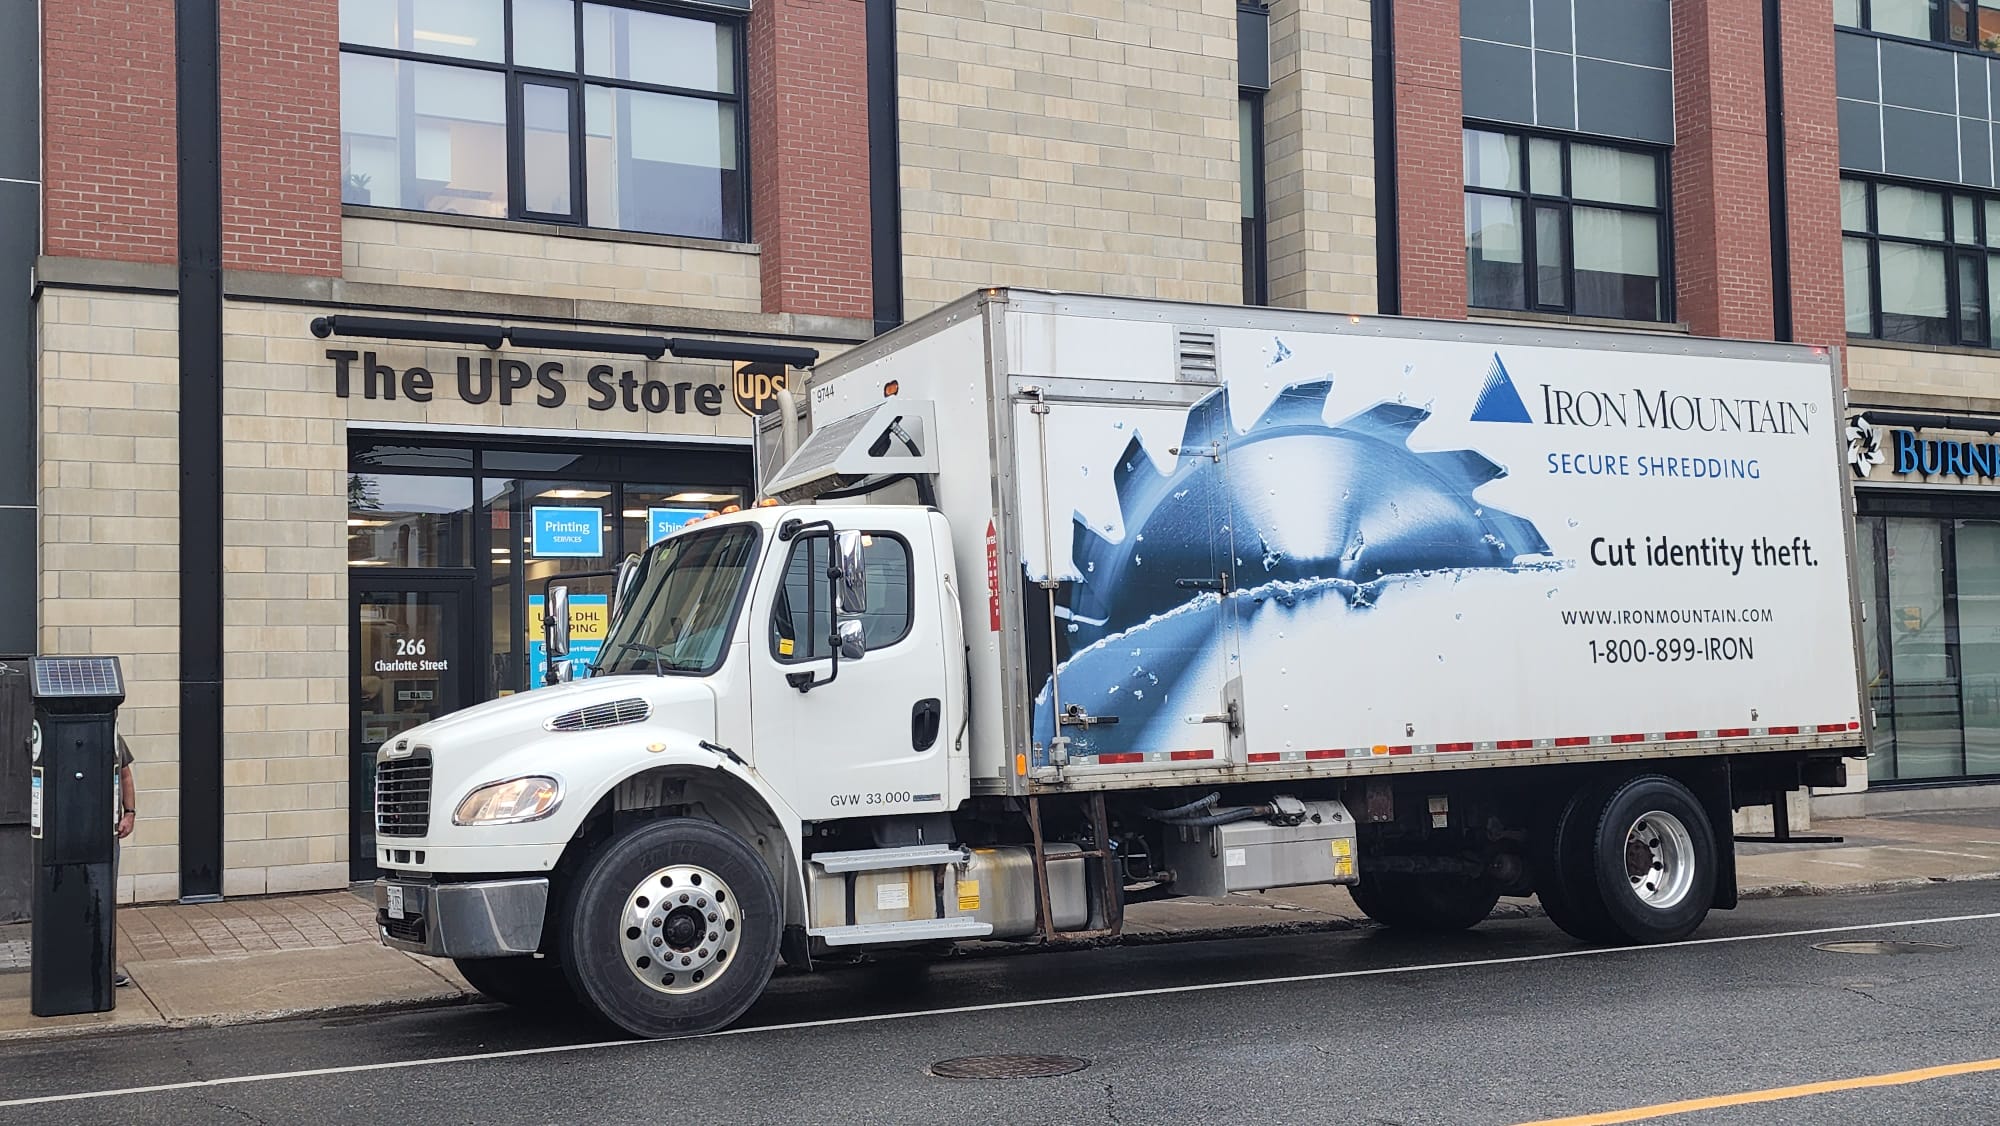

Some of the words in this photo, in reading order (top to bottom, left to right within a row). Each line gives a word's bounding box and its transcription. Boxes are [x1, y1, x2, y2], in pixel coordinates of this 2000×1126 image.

[326, 350, 434, 402] The
[456, 357, 567, 408] UPS
[587, 364, 723, 416] Store
[816, 384, 835, 403] 9744
[1539, 383, 1627, 427] IRON
[1547, 453, 1630, 475] SECURE
[1637, 457, 1760, 480] SHREDDING
[545, 521, 591, 535] Printing
[1590, 537, 1637, 567] Cut
[1645, 536, 1744, 575] identity
[1751, 537, 1818, 567] theft.
[575, 612, 601, 622] DHL
[1561, 608, 1773, 625] WWW.IRONMOUNTAIN.COM
[396, 638, 426, 656] 266
[1588, 636, 1754, 664] 1-800-899-IRON
[374, 659, 418, 672] Charlotte
[419, 659, 449, 671] Street
[830, 793, 861, 807] GVW
[865, 791, 911, 806] 33,000
